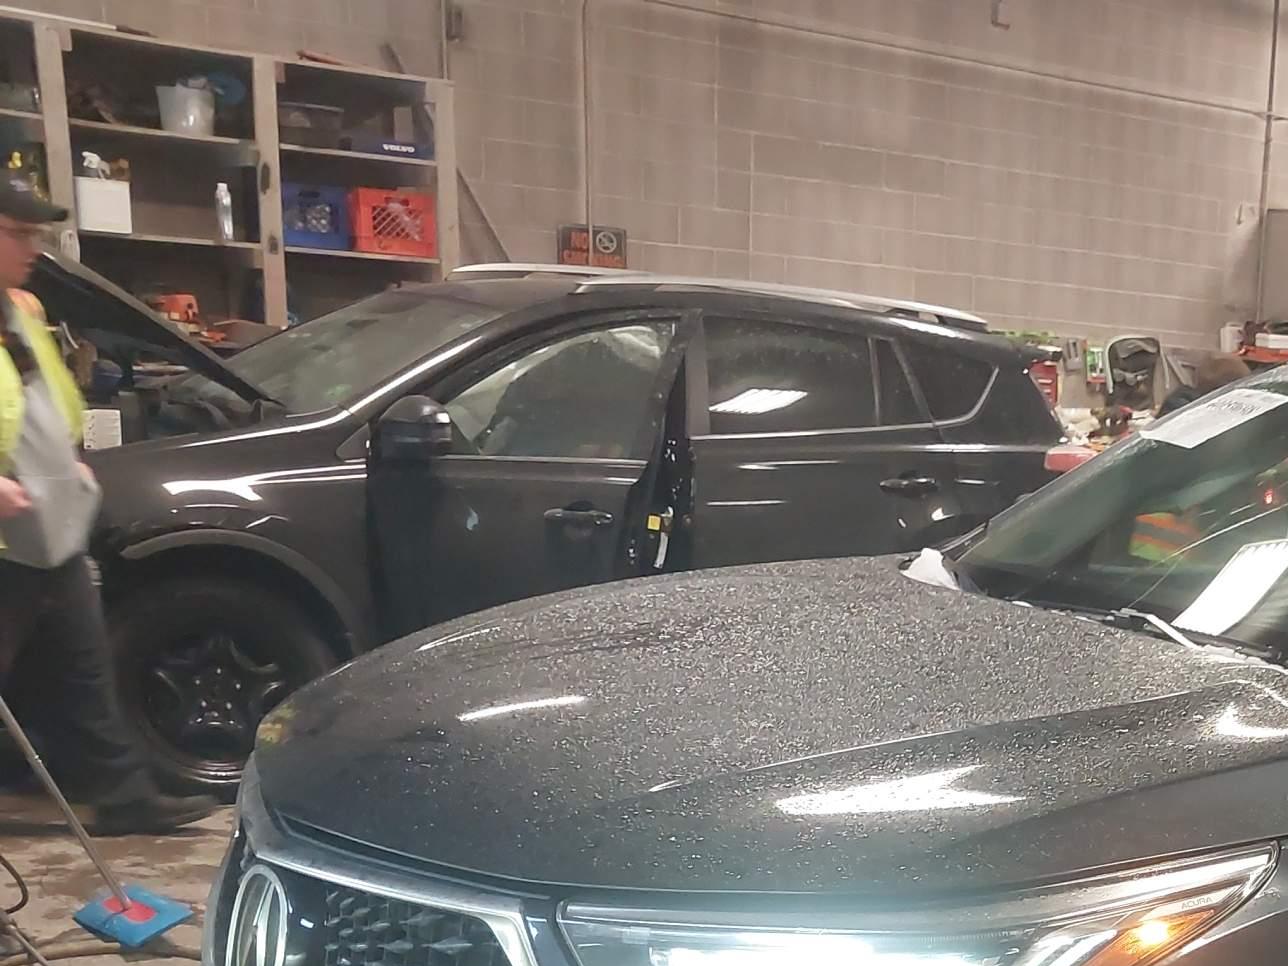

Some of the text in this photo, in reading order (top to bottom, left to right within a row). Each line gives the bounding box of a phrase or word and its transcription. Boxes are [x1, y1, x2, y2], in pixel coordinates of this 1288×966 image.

[382, 143, 416, 153] VOLVO
[570, 231, 589, 249] NO
[1181, 897, 1212, 909] ACURA
